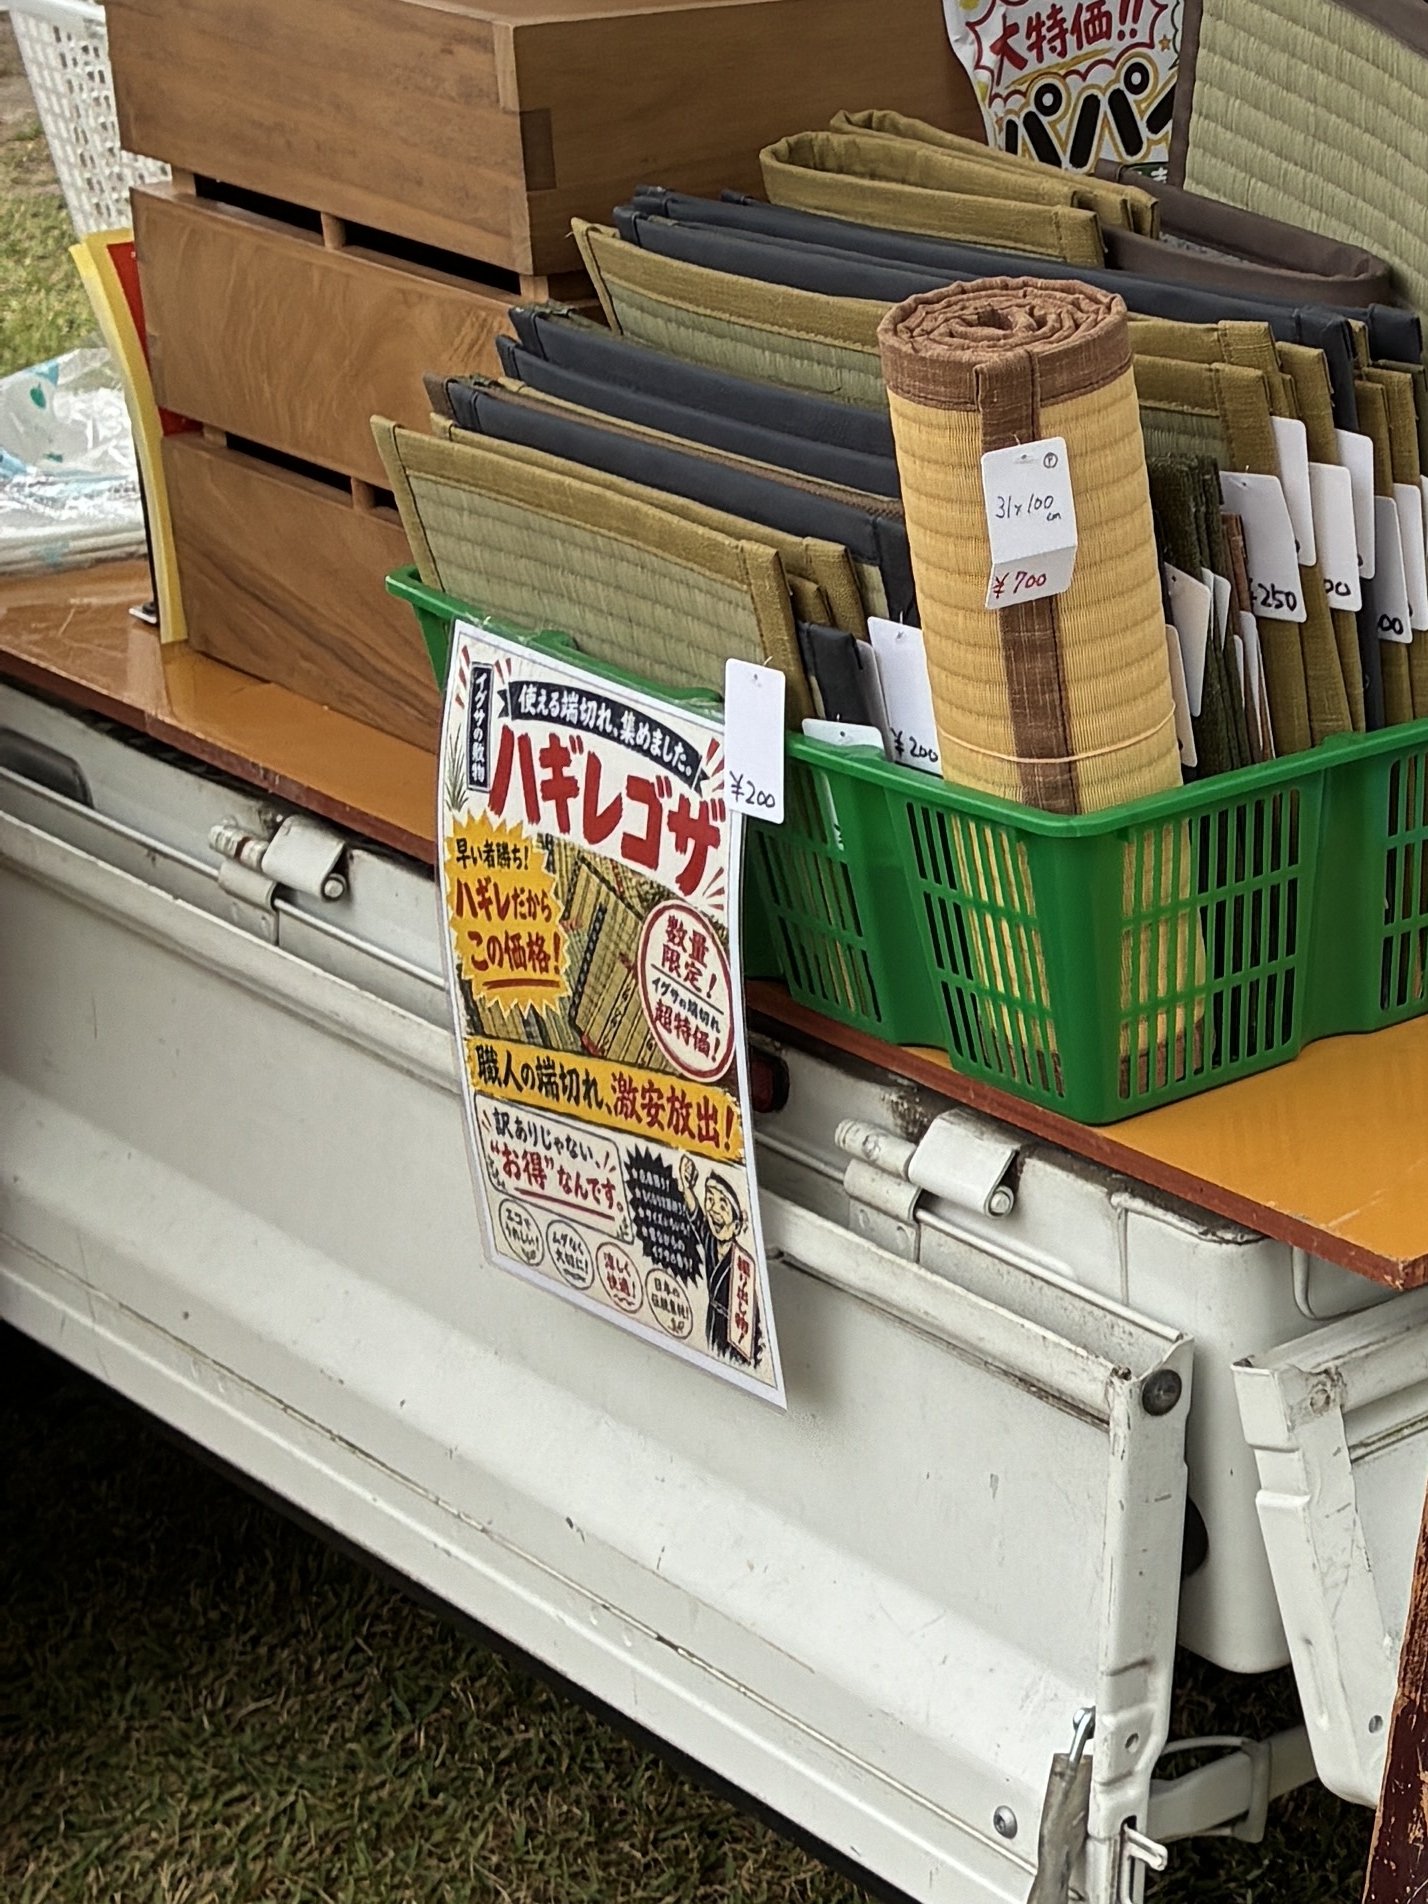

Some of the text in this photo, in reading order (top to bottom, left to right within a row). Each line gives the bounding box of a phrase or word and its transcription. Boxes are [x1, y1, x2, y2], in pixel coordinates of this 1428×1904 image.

[471, 672, 488, 783] イグサの敷物
[517, 682, 693, 778] 使える端切れ、集めました。
[893, 730, 939, 763] ¥200
[488, 724, 726, 897] ハギレゴザ
[729, 770, 776, 809] ¥200
[455, 837, 529, 871] 早い者勝ち!
[454, 877, 552, 922] ハギレだから
[466, 929, 562, 975] この価格!
[665, 913, 710, 969] 数量
[661, 943, 718, 999] 限定!
[652, 998, 721, 1063] 超特価!
[475, 1043, 736, 1152] 職人の端切れ、激安放出!
[491, 1105, 606, 1170] 訳ありじゃない、
